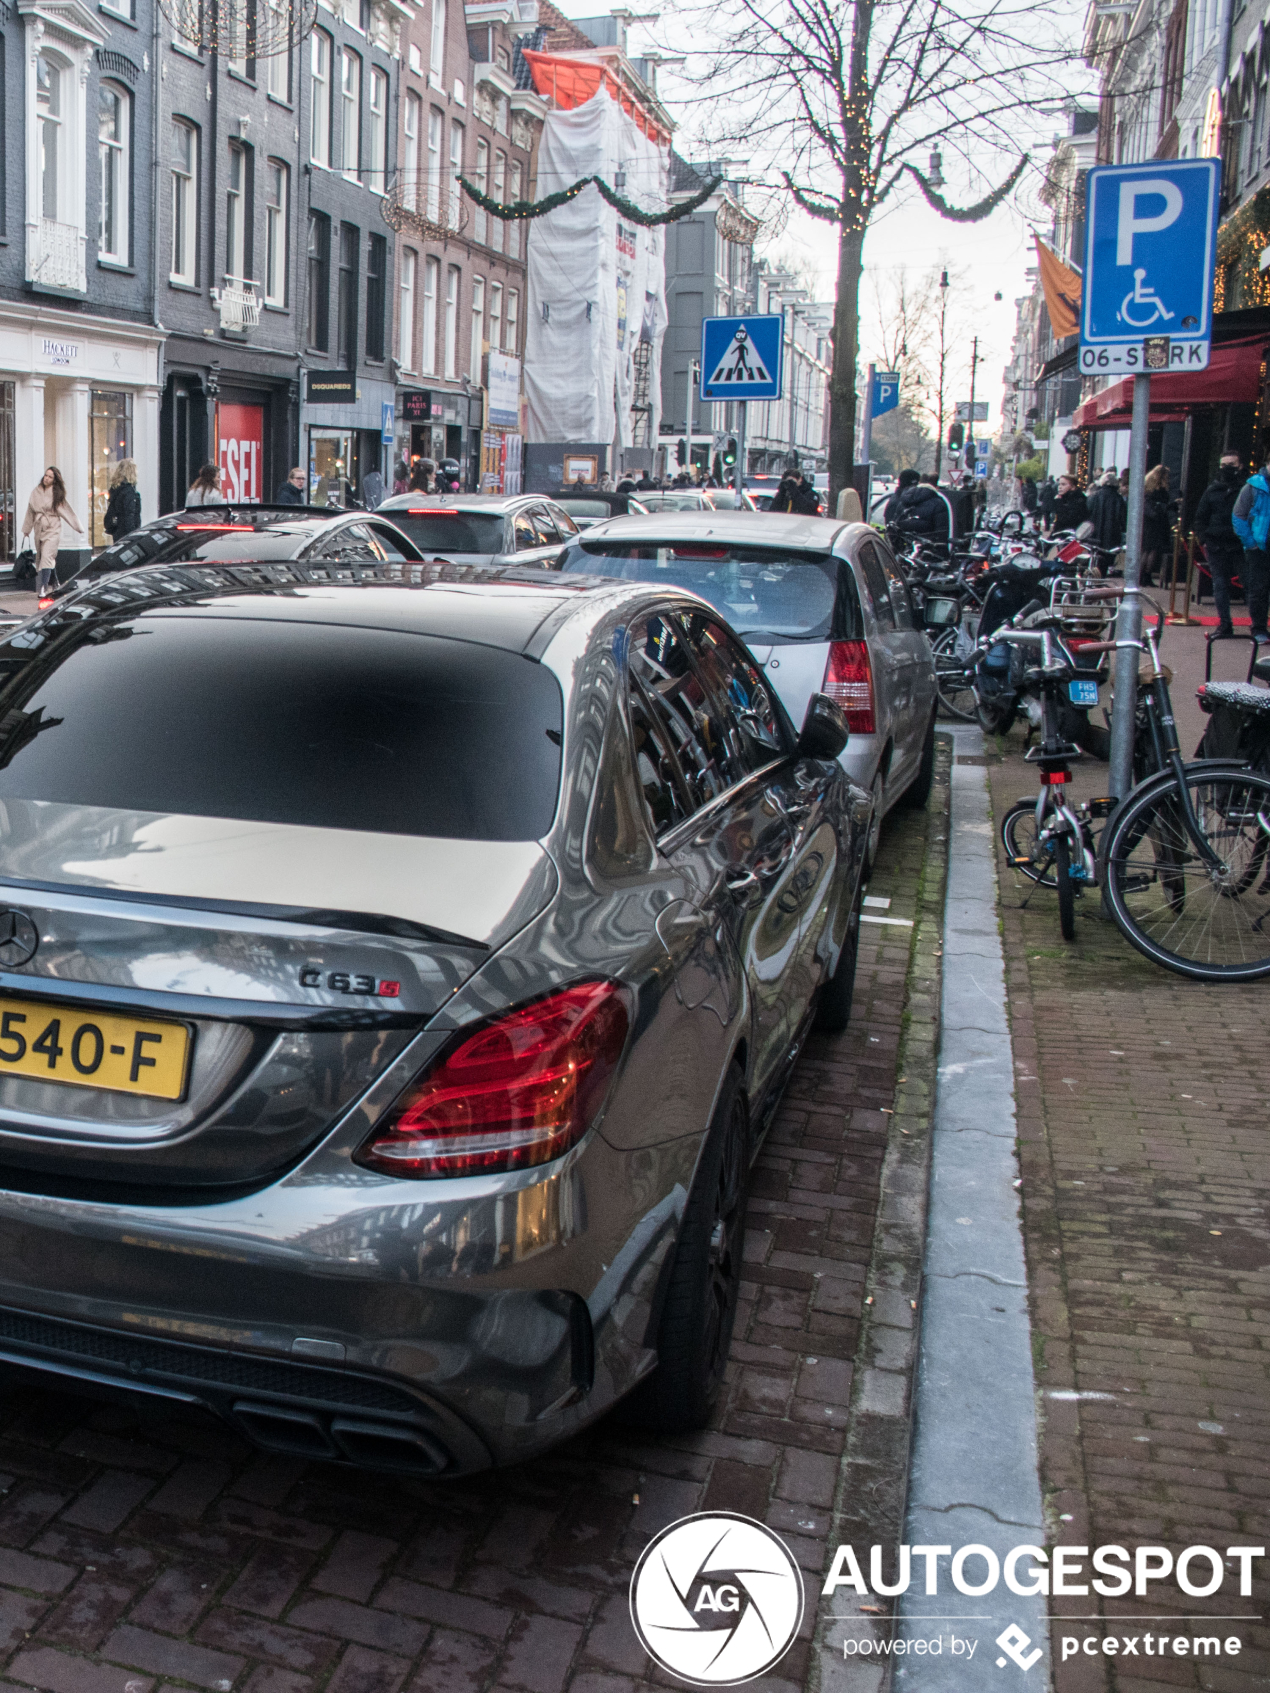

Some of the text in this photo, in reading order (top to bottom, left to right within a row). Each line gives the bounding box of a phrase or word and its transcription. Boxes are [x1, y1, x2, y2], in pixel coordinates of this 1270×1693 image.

[1116, 179, 1183, 266] P
[43, 339, 78, 357] HACKETT
[880, 384, 892, 404] P
